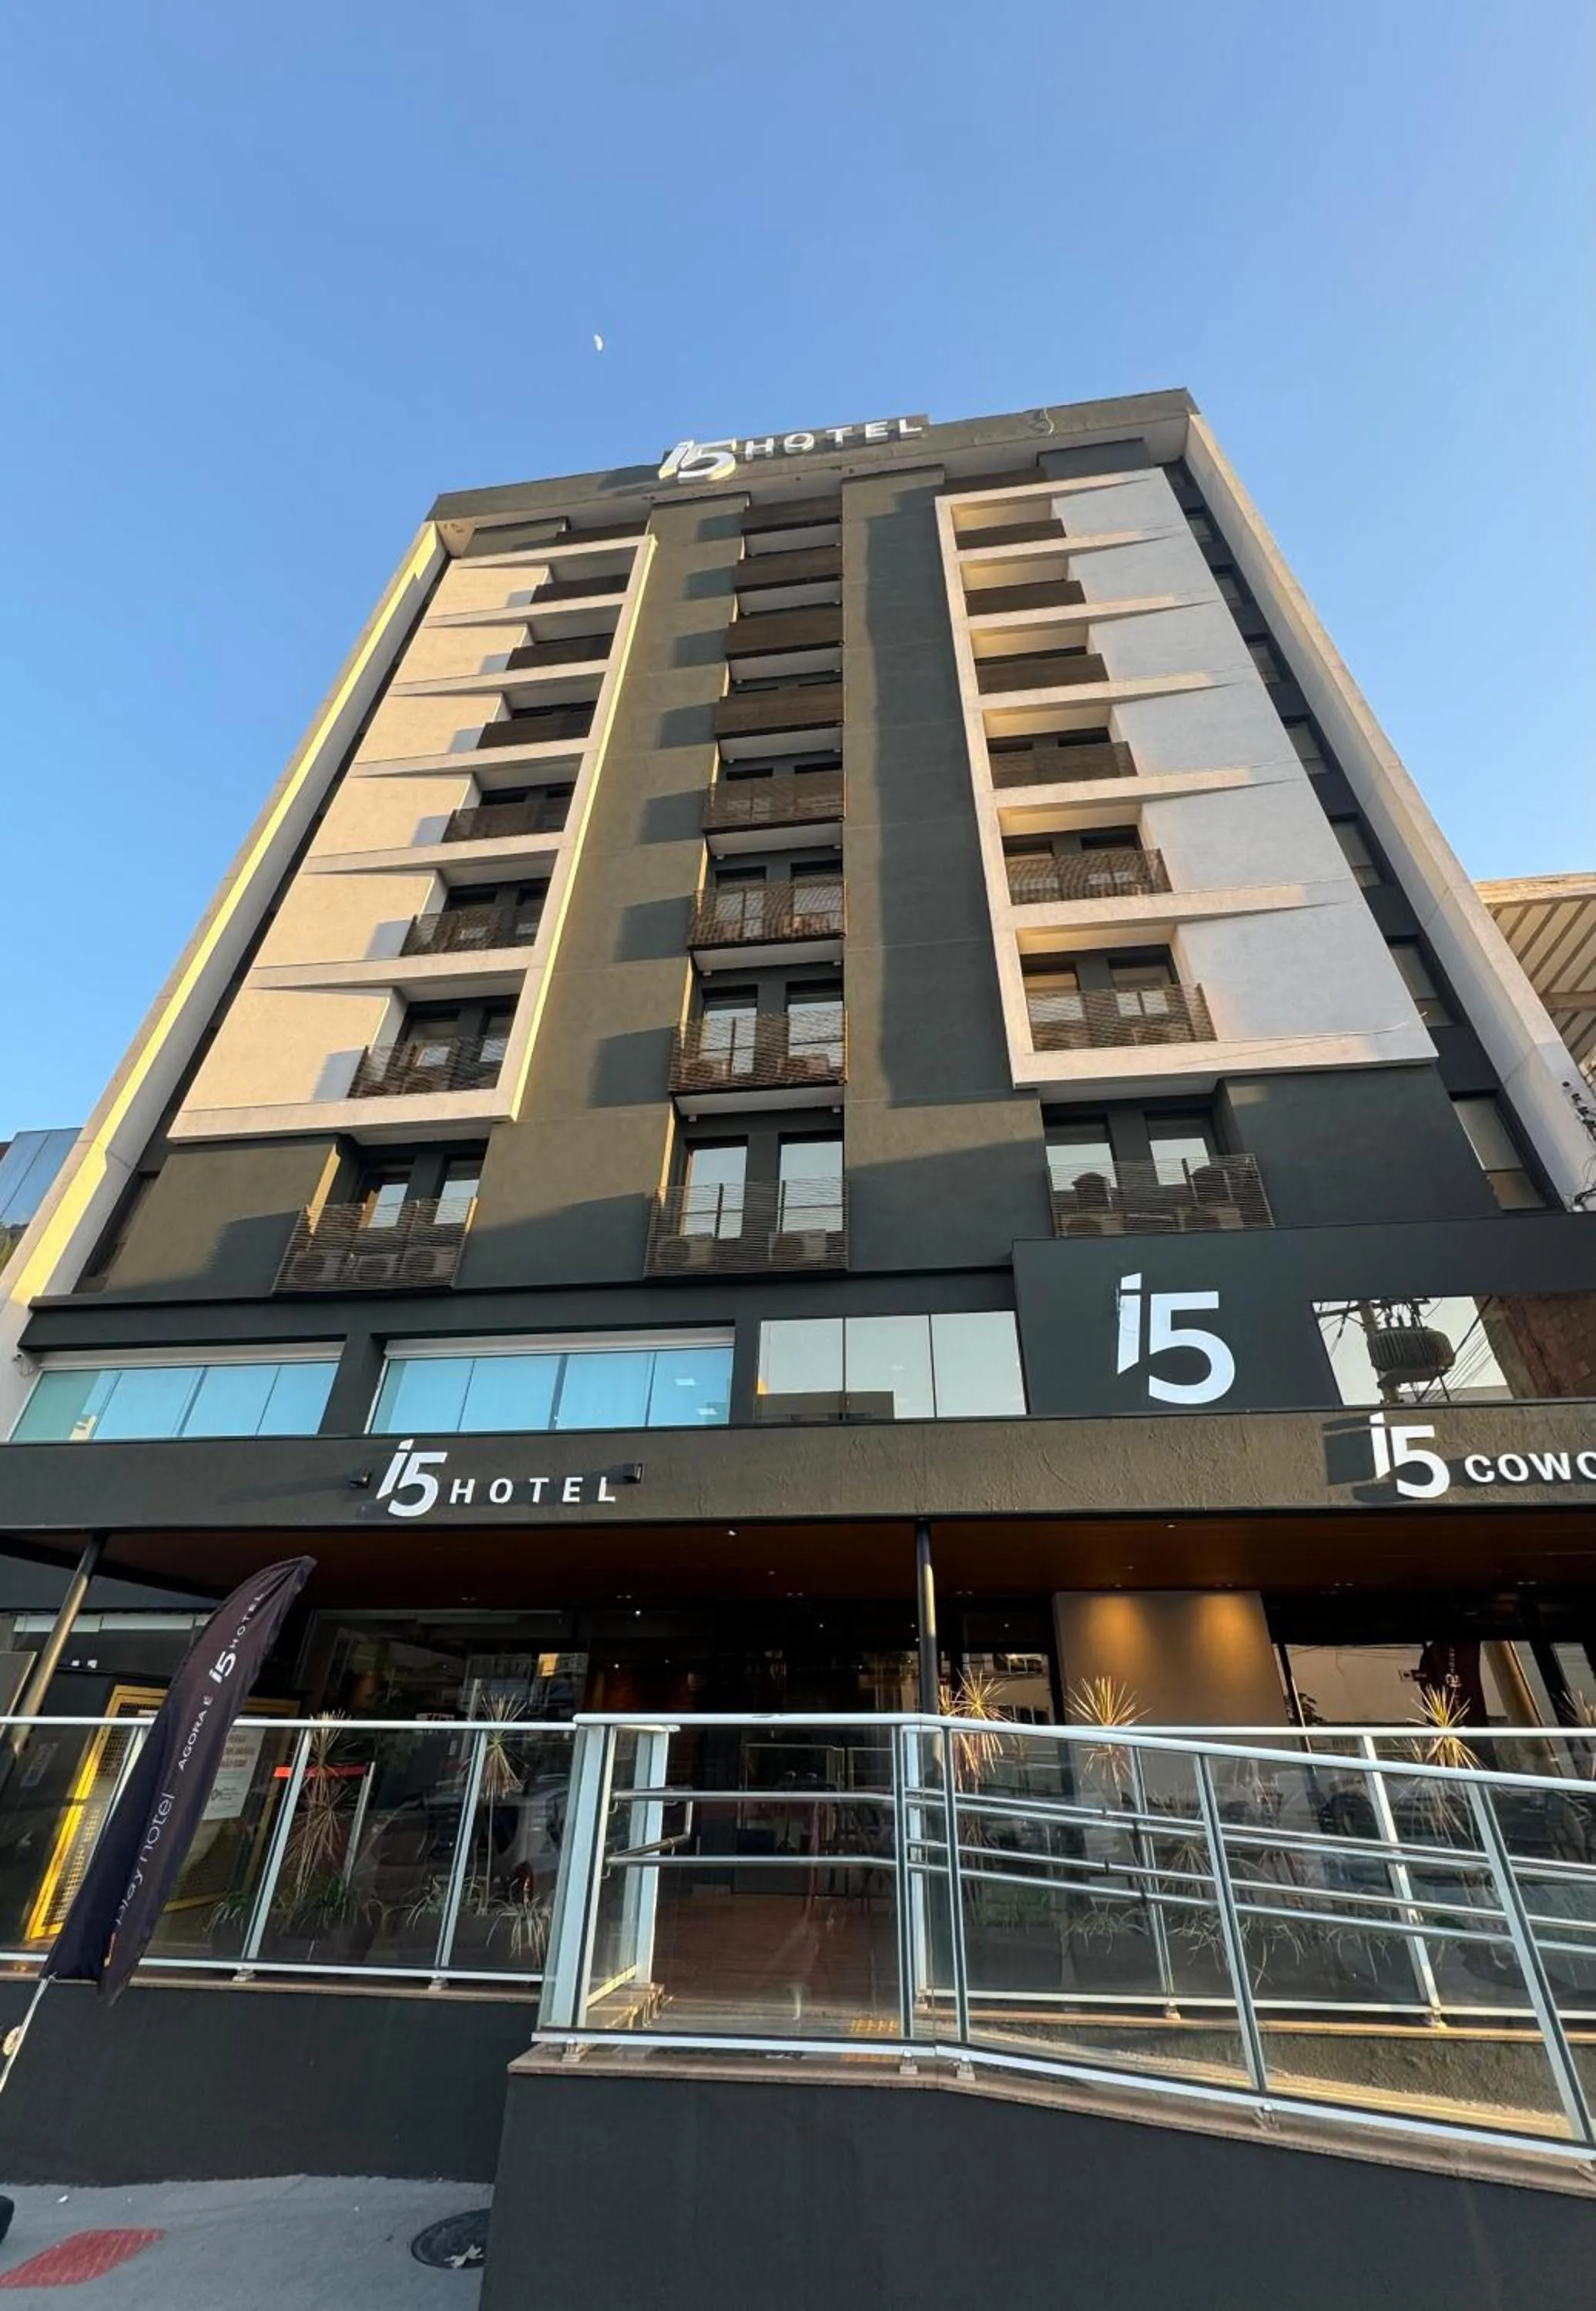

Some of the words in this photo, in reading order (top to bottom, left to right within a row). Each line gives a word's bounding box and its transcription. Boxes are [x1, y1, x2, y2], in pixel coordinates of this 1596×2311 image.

[744, 418, 924, 461] HOTEL
[1117, 1272, 1236, 1404] i5
[376, 1438, 448, 1517] i5
[449, 1477, 616, 1504] HOTEL
[1369, 1412, 1450, 1498] i5
[178, 1709, 207, 1771] AGORA
[209, 1651, 236, 1684] i5
[229, 1593, 266, 1649] HOTEL
